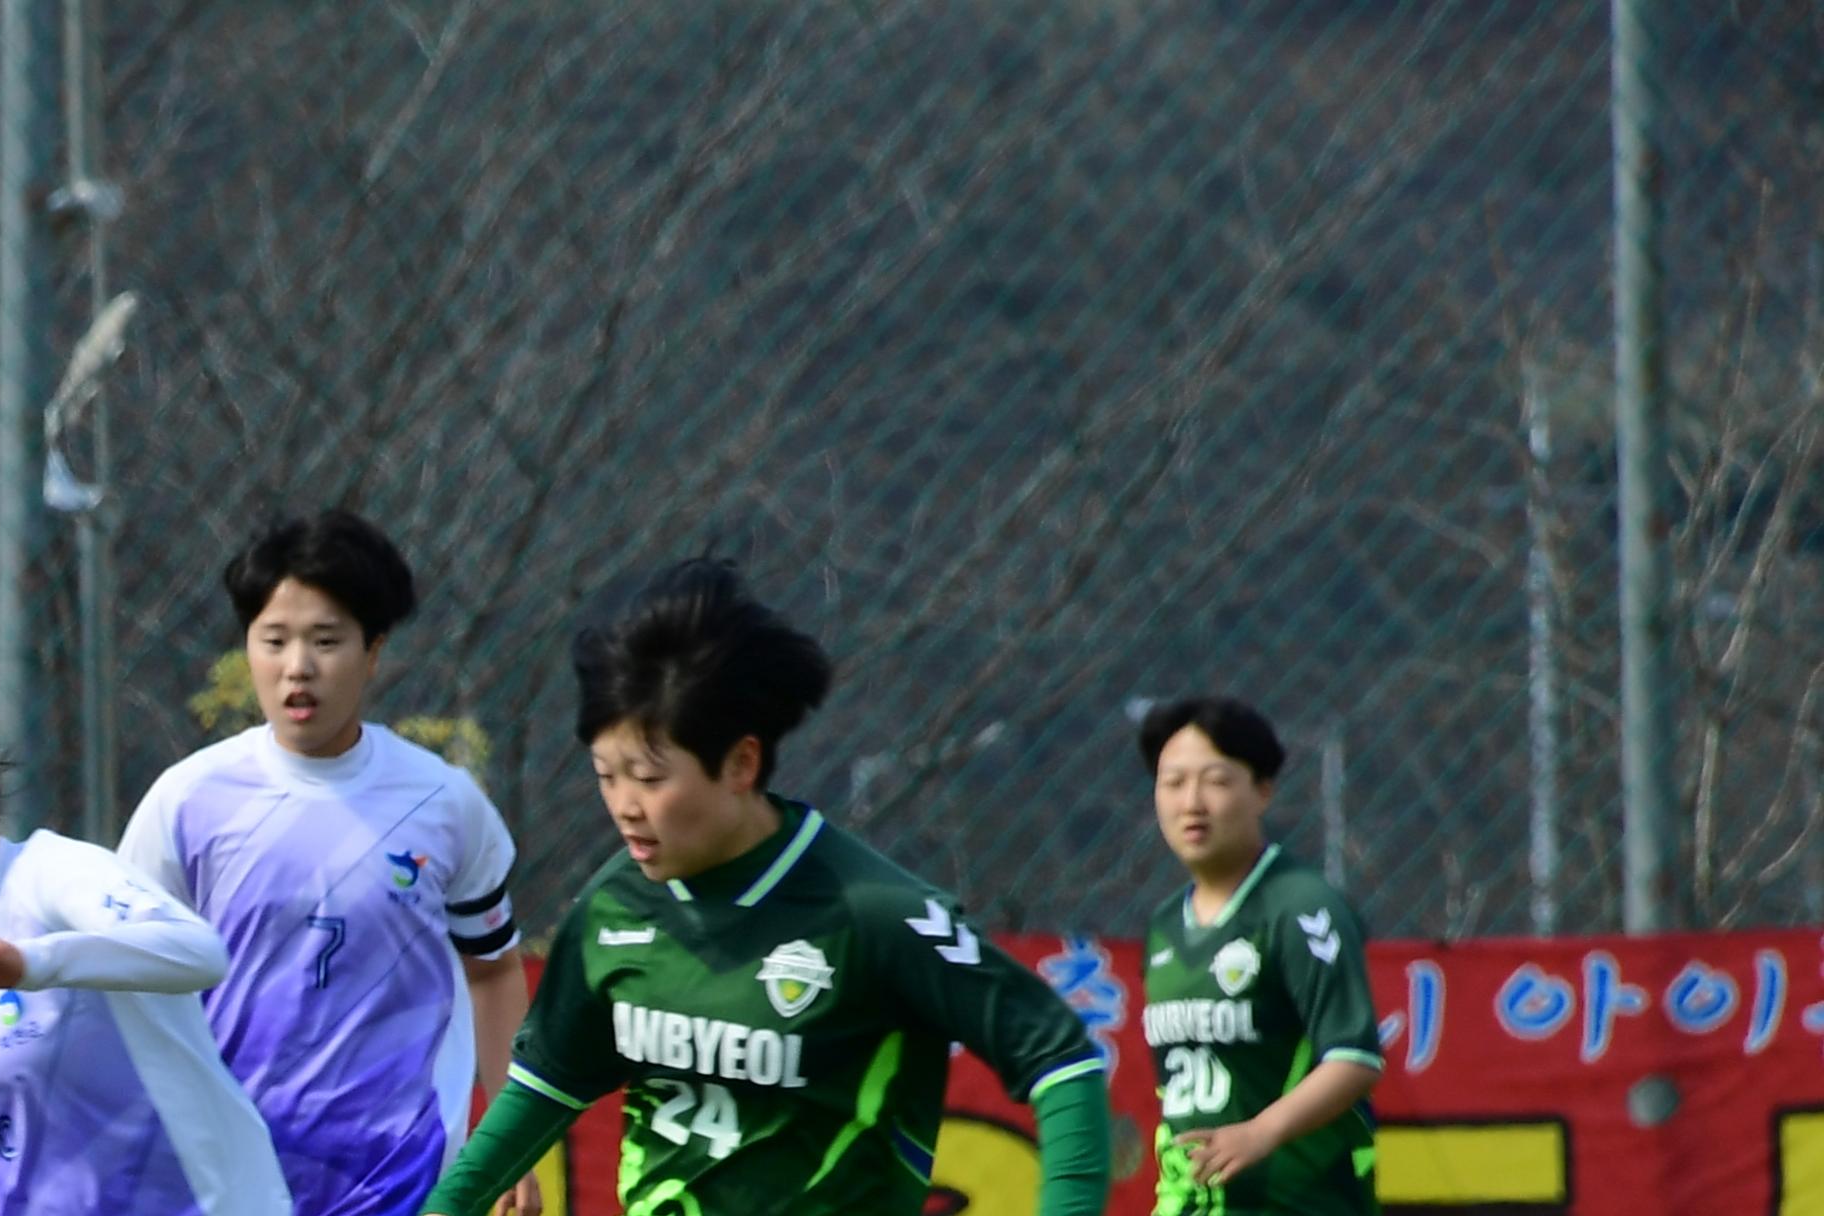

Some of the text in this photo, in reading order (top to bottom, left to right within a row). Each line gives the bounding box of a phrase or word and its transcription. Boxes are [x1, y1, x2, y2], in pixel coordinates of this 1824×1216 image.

[306, 914, 346, 989] 7
[1494, 948, 1824, 1065] 아이
[646, 1078, 743, 1160] 24
[1162, 1046, 1232, 1118] 20
